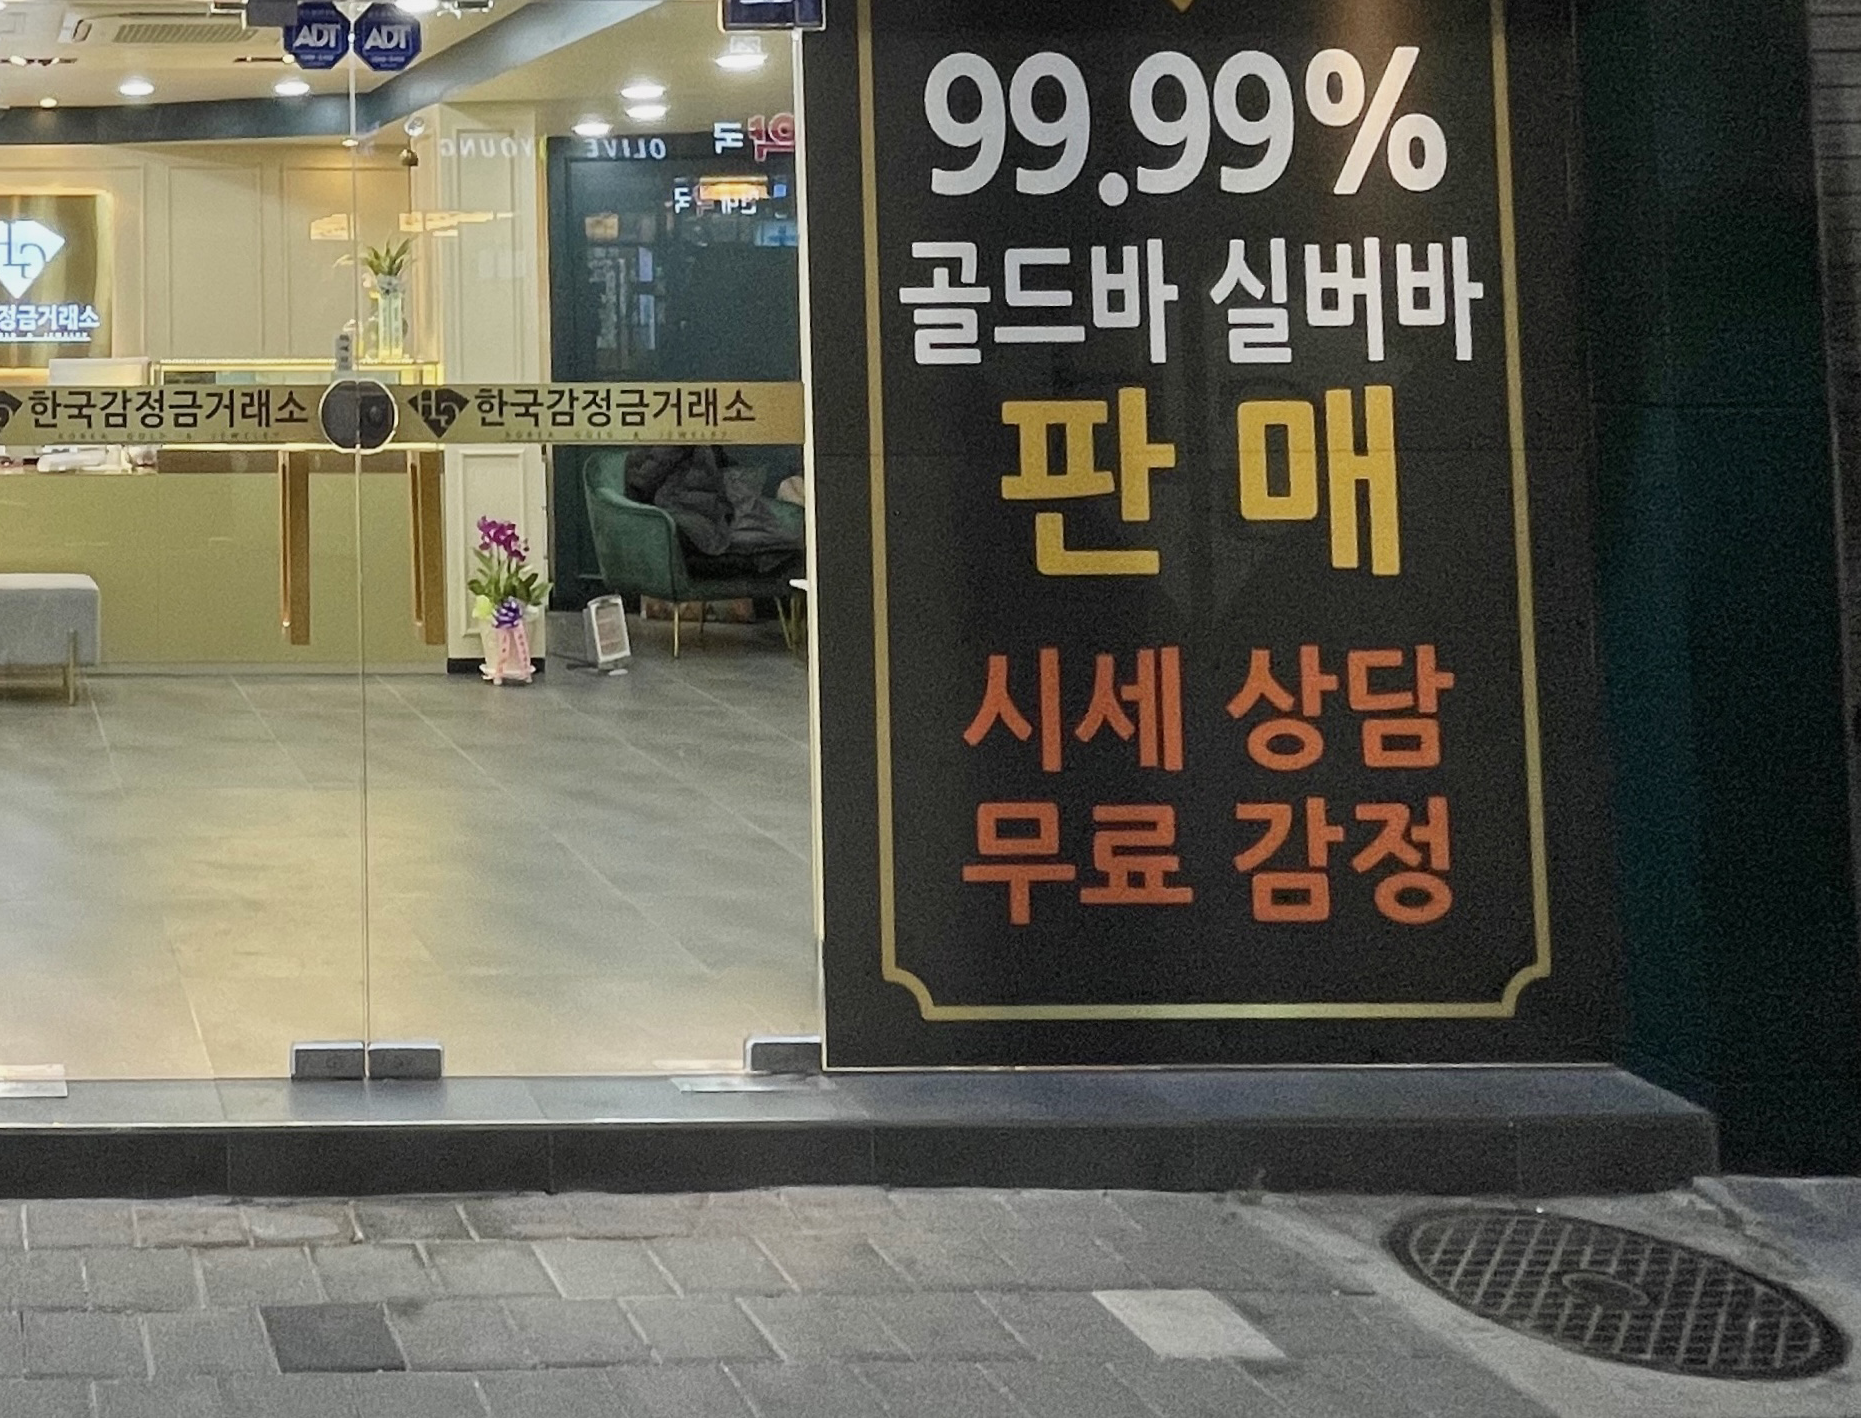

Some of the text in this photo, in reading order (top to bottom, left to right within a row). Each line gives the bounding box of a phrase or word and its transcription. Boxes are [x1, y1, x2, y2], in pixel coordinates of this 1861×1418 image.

[293, 23, 341, 48] ADT
[363, 25, 412, 50] ADT
[924, 47, 1448, 207] 99.99%
[899, 237, 1483, 364] 골드바 실버바
[28, 388, 309, 431] 한국감정금거래소
[475, 387, 757, 429] 한국감정금거래소
[962, 644, 1455, 773] 시세 상담
[962, 796, 1454, 925] 무료 감정
